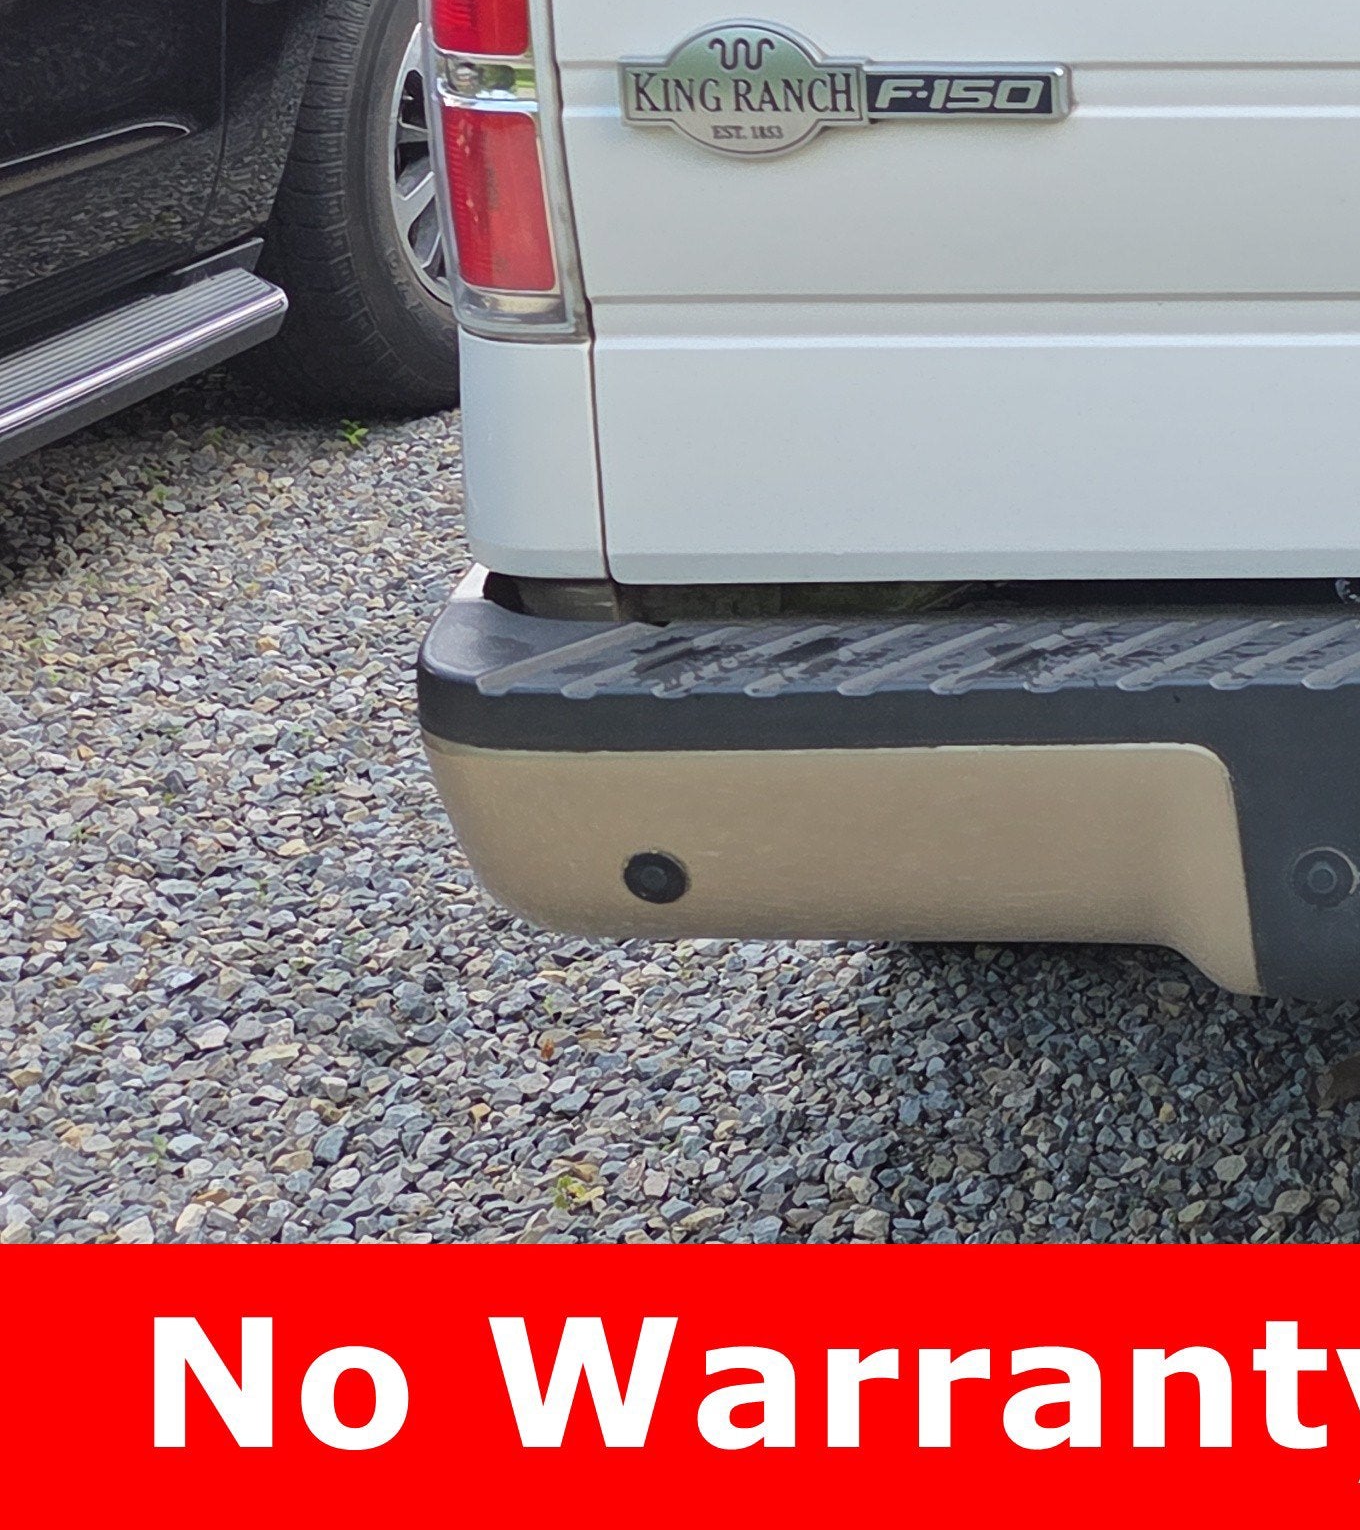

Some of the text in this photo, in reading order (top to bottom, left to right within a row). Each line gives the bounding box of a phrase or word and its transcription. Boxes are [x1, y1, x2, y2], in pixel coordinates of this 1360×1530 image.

[632, 71, 856, 113] KING RANCH
[874, 77, 1046, 111] F-150
[712, 124, 784, 140] EST. 1853
